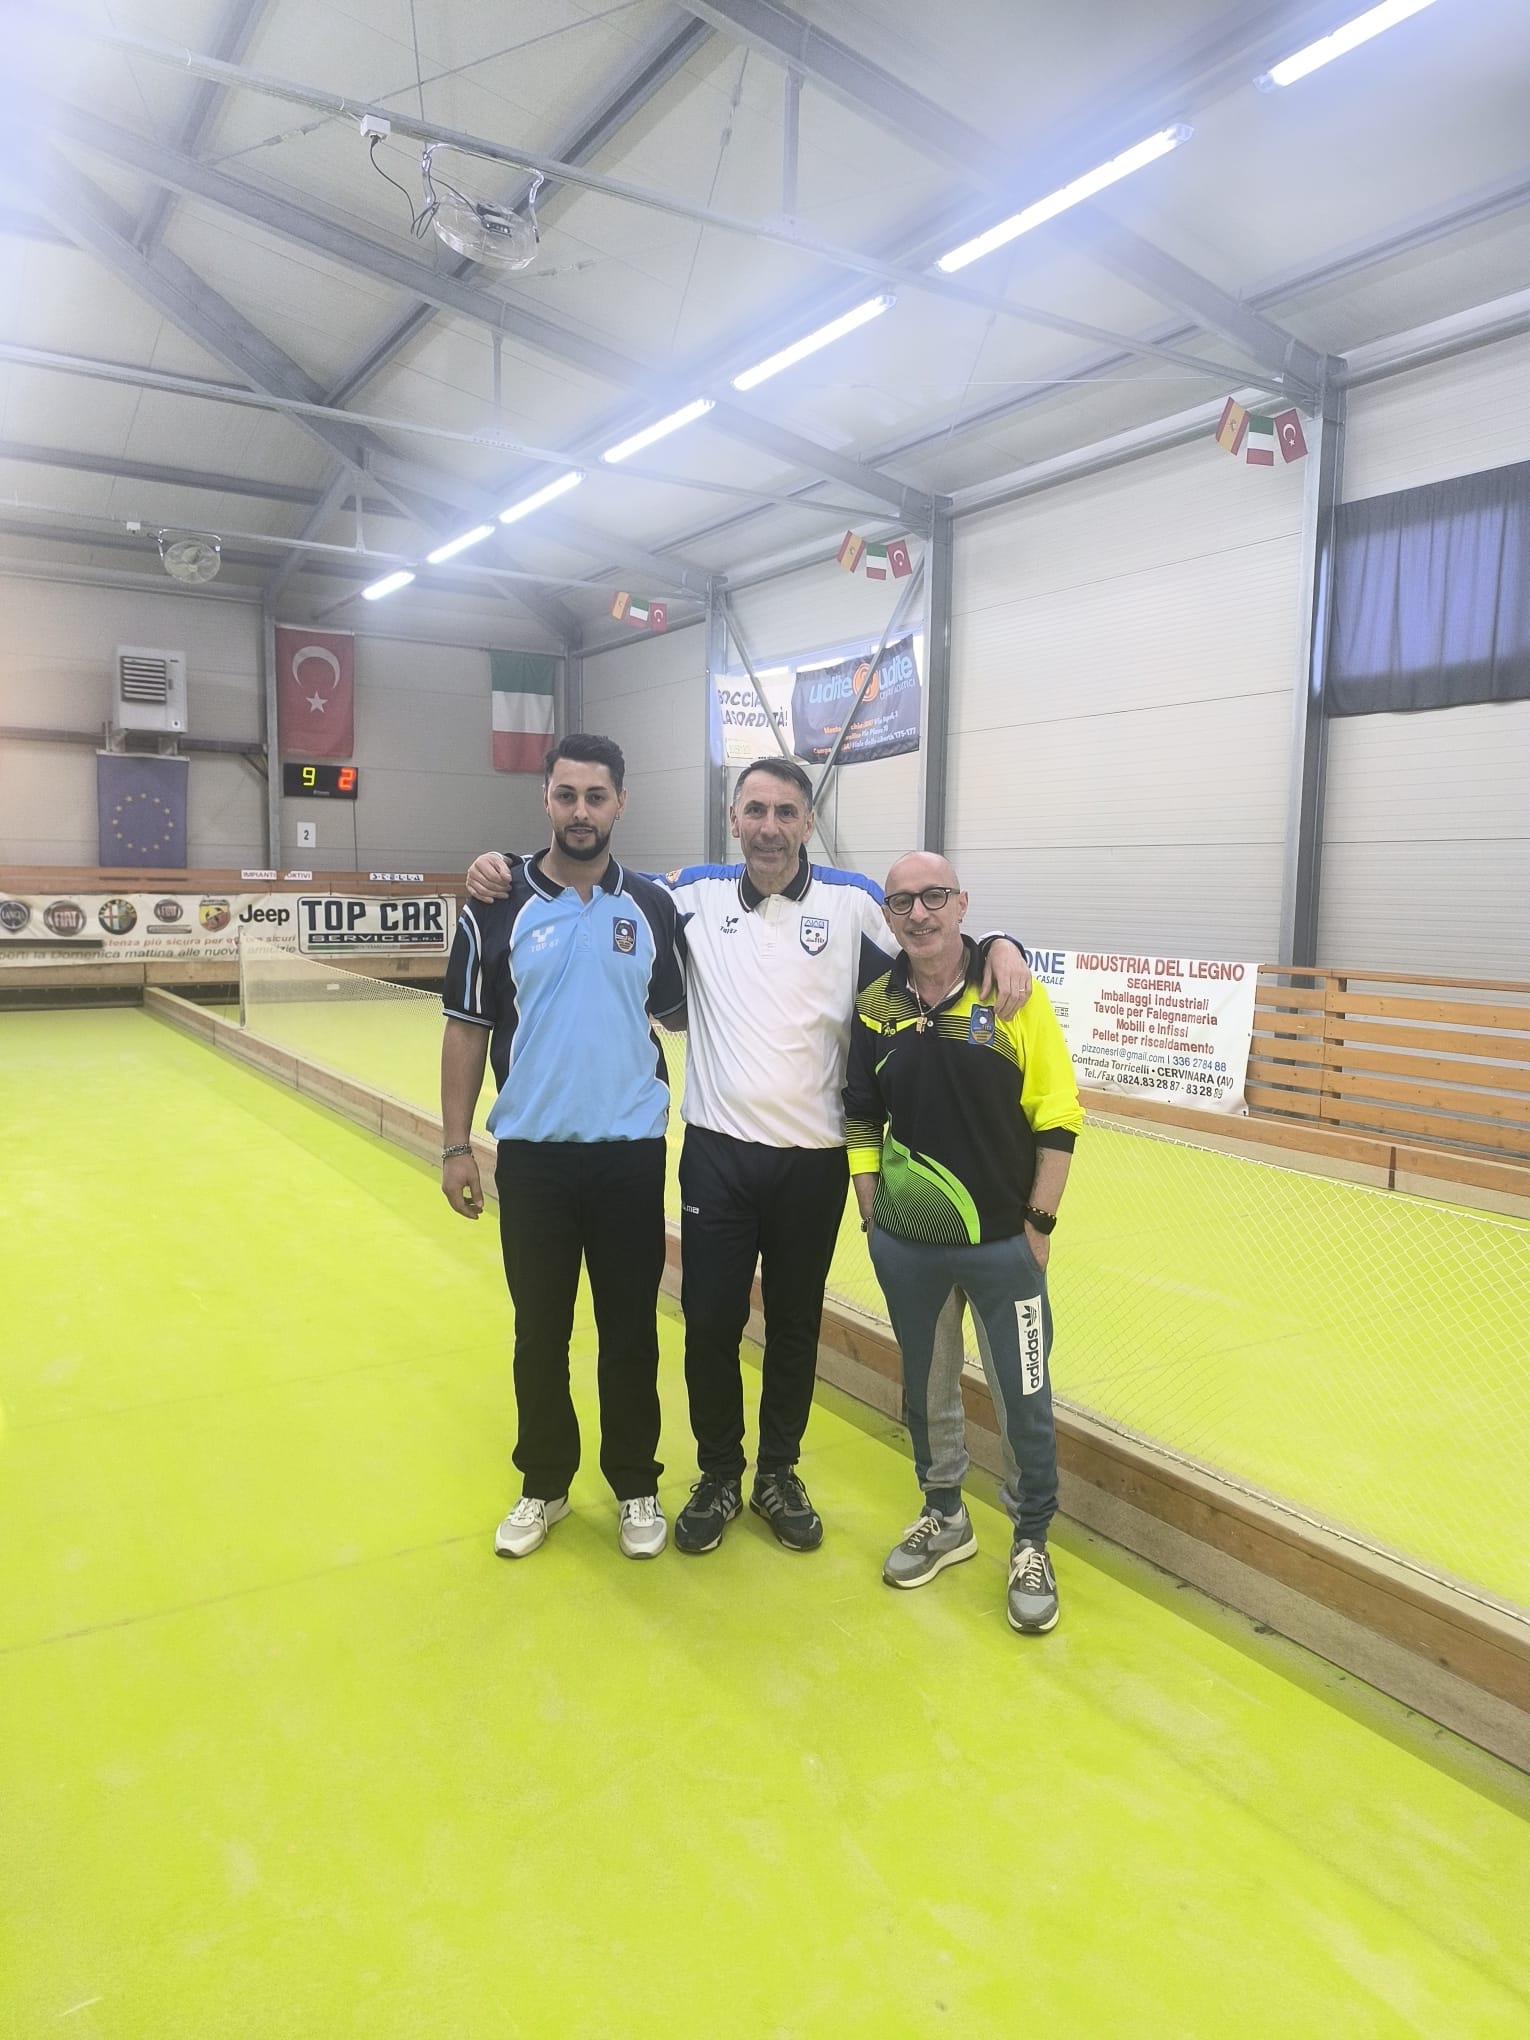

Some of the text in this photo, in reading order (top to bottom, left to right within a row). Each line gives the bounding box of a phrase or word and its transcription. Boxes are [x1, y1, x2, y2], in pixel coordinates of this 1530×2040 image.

[879, 655, 913, 690] udite
[303, 767, 356, 789] 9 2
[304, 830, 310, 840] 2
[54, 911, 77, 927] FIAT
[239, 904, 290, 926] Jeep
[301, 900, 444, 931] TOP CAR
[311, 934, 410, 942] SERVICE
[1076, 953, 1245, 982] INDUSTRIA DEL LEGNO
[1126, 977, 1182, 993] SEGHERIA
[1101, 988, 1152, 1007] Imballaggi
[1093, 1001, 1218, 1026] Tavole per Falegnameria
[1116, 1018, 1189, 1038] Mobili e Infissi
[1092, 1028, 1215, 1055] Pellet per riscaldamento
[1071, 1053, 1110, 1068] Contrada
[1111, 1060, 1150, 1075] Torricelli
[1157, 1067, 1215, 1084] CERVINARA
[1216, 1075, 1234, 1090] (AV)
[1172, 1056, 1191, 1067] 336
[1192, 1058, 1213, 1070] 2784
[1214, 1061, 1227, 1072] 88
[1084, 1067, 1115, 1082] Tel./Fax
[1116, 1073, 1155, 1088] 0824.83
[1156, 1078, 1169, 1090] 28
[1169, 1080, 1181, 1091] 87
[1186, 1084, 1198, 1095] 83
[1199, 1085, 1213, 1097] 28
[1025, 1328, 1040, 1389] adidas
